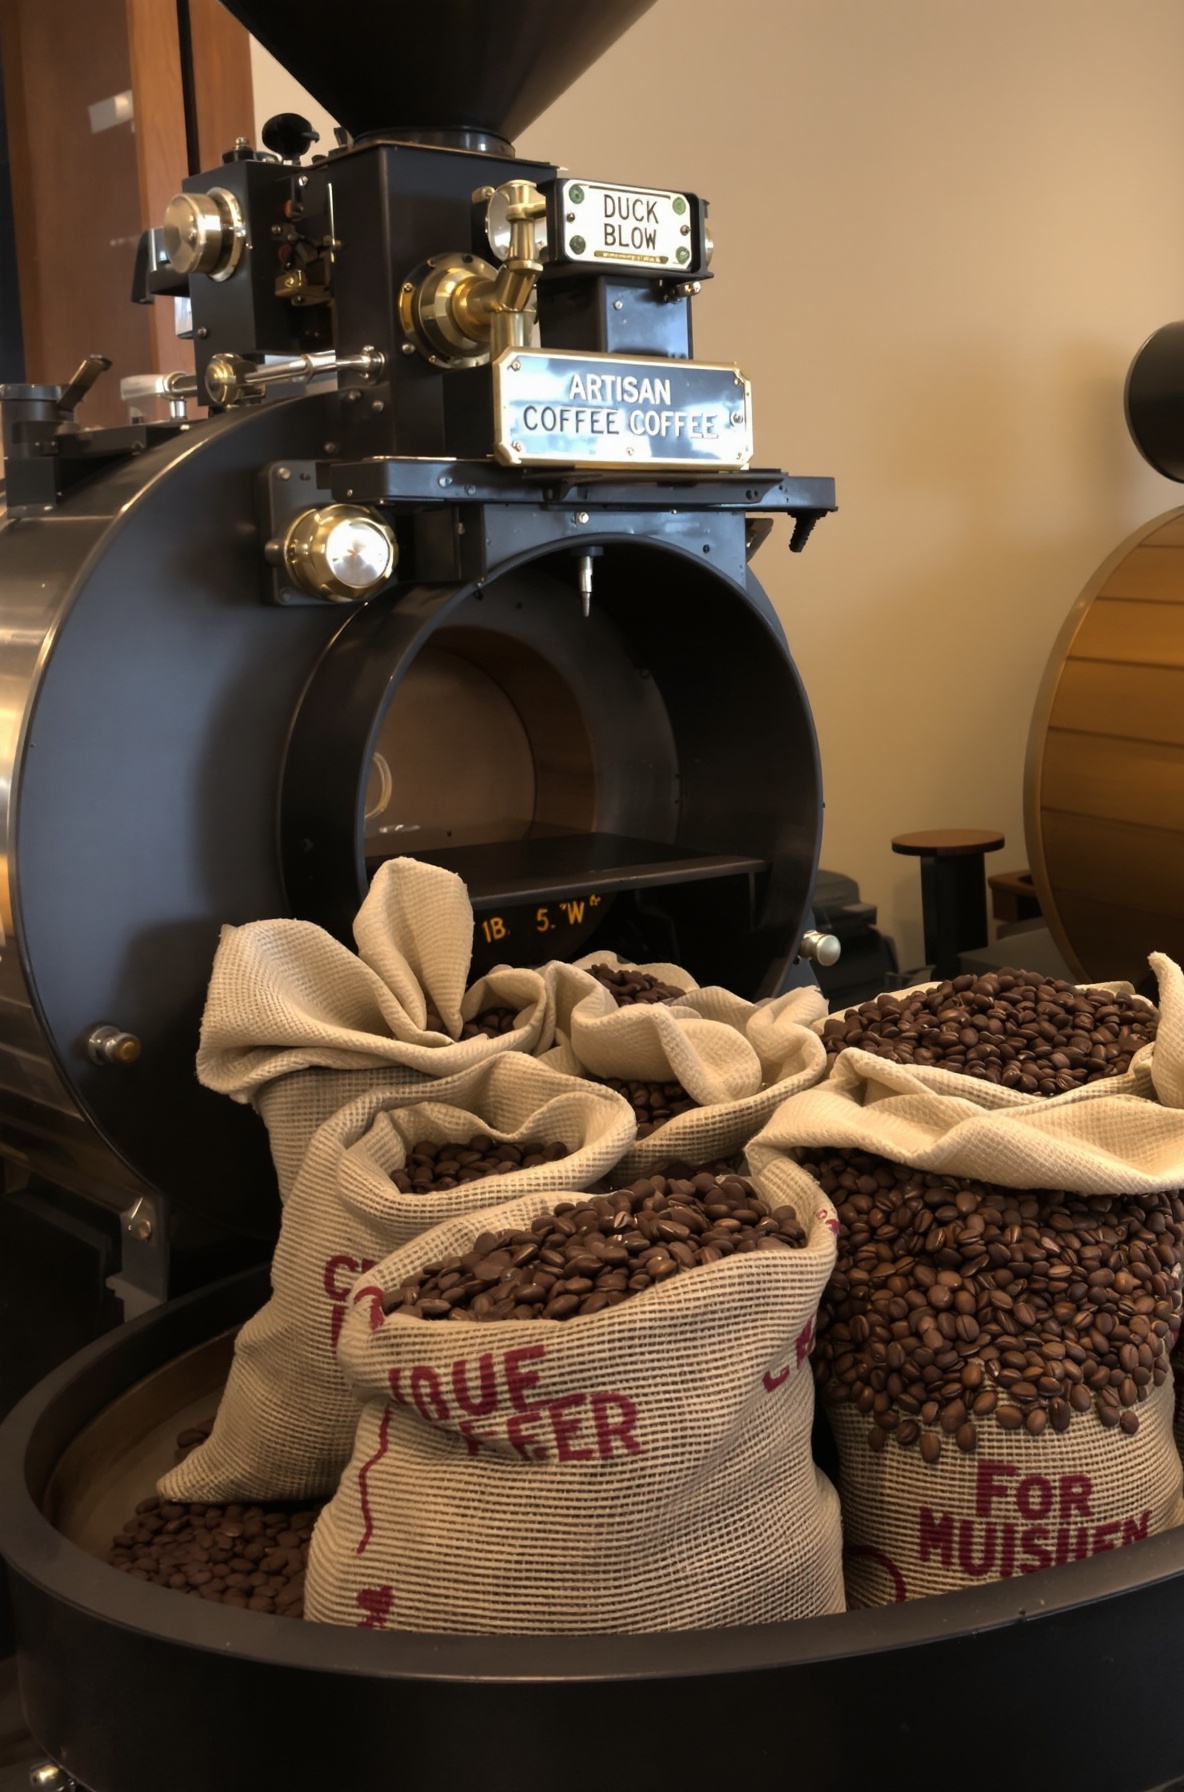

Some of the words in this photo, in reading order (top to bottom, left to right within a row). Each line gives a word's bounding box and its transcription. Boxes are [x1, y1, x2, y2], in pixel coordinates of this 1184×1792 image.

[603, 194, 659, 225] DUCK
[603, 223, 657, 250] BLOW
[569, 373, 671, 406] ARTISAN
[523, 405, 620, 435] COFFEE
[629, 409, 719, 439] COFFEE
[975, 1459, 1094, 1521] FOR
